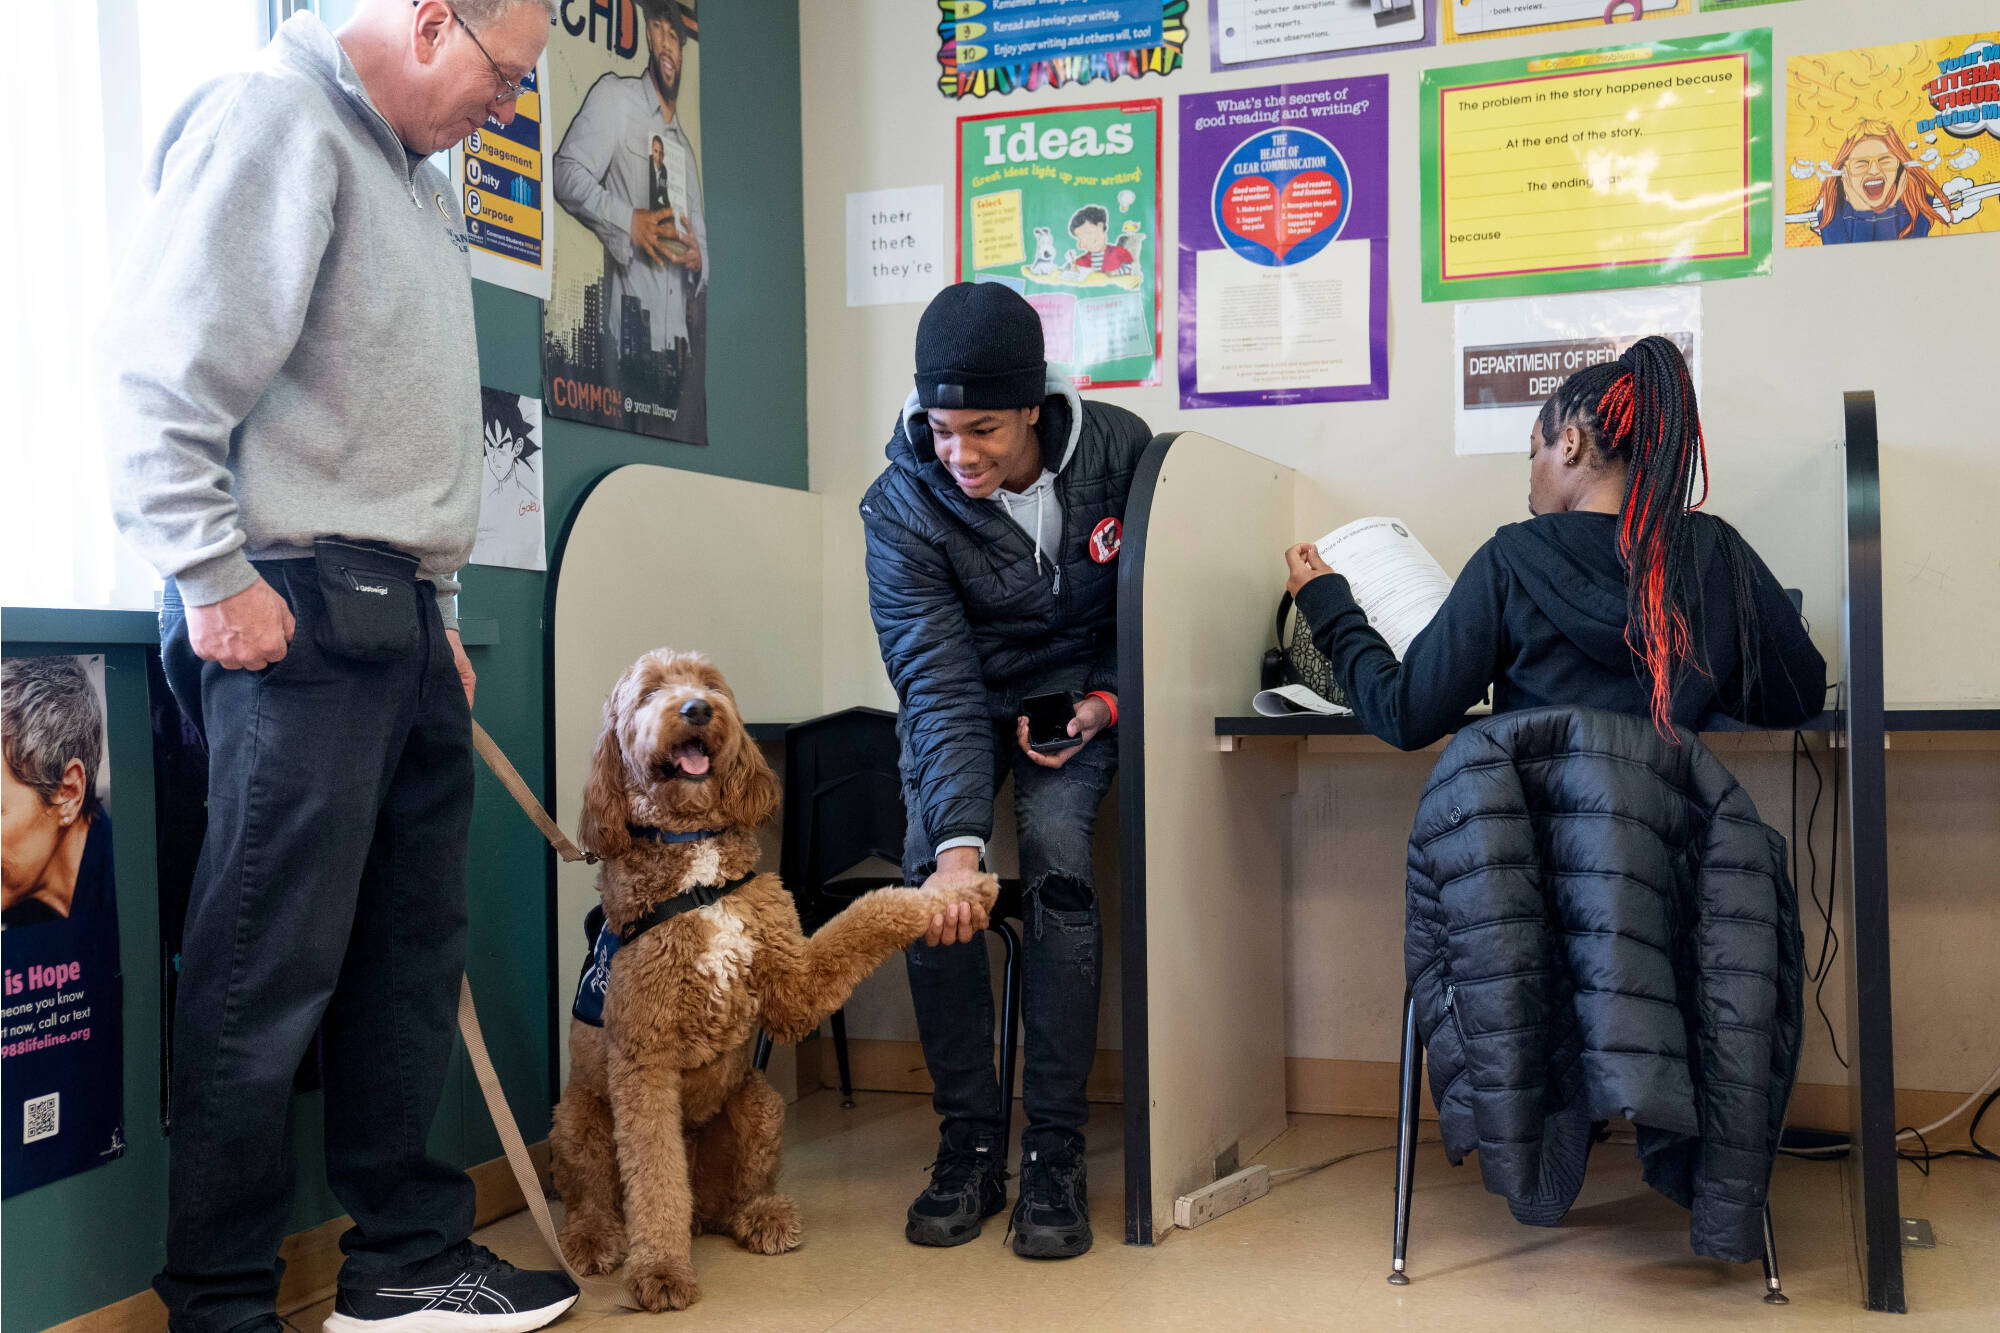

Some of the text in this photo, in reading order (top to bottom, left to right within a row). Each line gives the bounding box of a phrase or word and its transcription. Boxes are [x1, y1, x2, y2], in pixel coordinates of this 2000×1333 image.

[993, 18, 1023, 32] Reread
[1024, 15, 1040, 29] and
[1041, 15, 1065, 27] revise
[1066, 13, 1087, 26] your
[963, 47, 976, 60] 10
[994, 43, 1016, 57] Enjoy
[1017, 40, 1036, 54] your
[1037, 35, 1067, 50] writing
[1068, 34, 1084, 47] and
[1085, 32, 1115, 45] others
[1133, 26, 1151, 38] too!
[1216, 88, 1349, 112] What's the secret of
[1459, 71, 1733, 112] The problem in the story happened because
[1195, 99, 1370, 131] good reading and writing?
[1916, 107, 1981, 134] Driving
[470, 132, 533, 168] Engagement
[984, 122, 1134, 165] Ideas
[1271, 133, 1288, 147] THE
[1506, 126, 1643, 149] At the end of the story,
[1234, 156, 1326, 175] CLEAR COMMUNICATION
[1260, 146, 1299, 160] HEART OF
[470, 163, 500, 190] Unity
[972, 163, 1142, 187] Great ideas light up your writing!
[1527, 182, 1547, 192] The
[1551, 176, 1594, 190] ending
[470, 194, 514, 224] Purpose
[872, 210, 912, 226] their
[872, 236, 916, 251] there
[1450, 230, 1501, 243] because
[873, 260, 933, 278] they're
[1469, 351, 1562, 376] DEPARTMENT
[1564, 350, 1582, 369] OF
[553, 376, 678, 422] COMMON @ your library
[4, 960, 81, 996] is Hope
[35, 998, 55, 1013] you
[57, 990, 85, 1005] know
[9, 1021, 36, 1036] now,
[38, 1012, 57, 1030] call
[59, 1014, 71, 1024] or
[73, 1007, 91, 1020] text
[1, 1027, 91, 1059] 988lifeline.org
